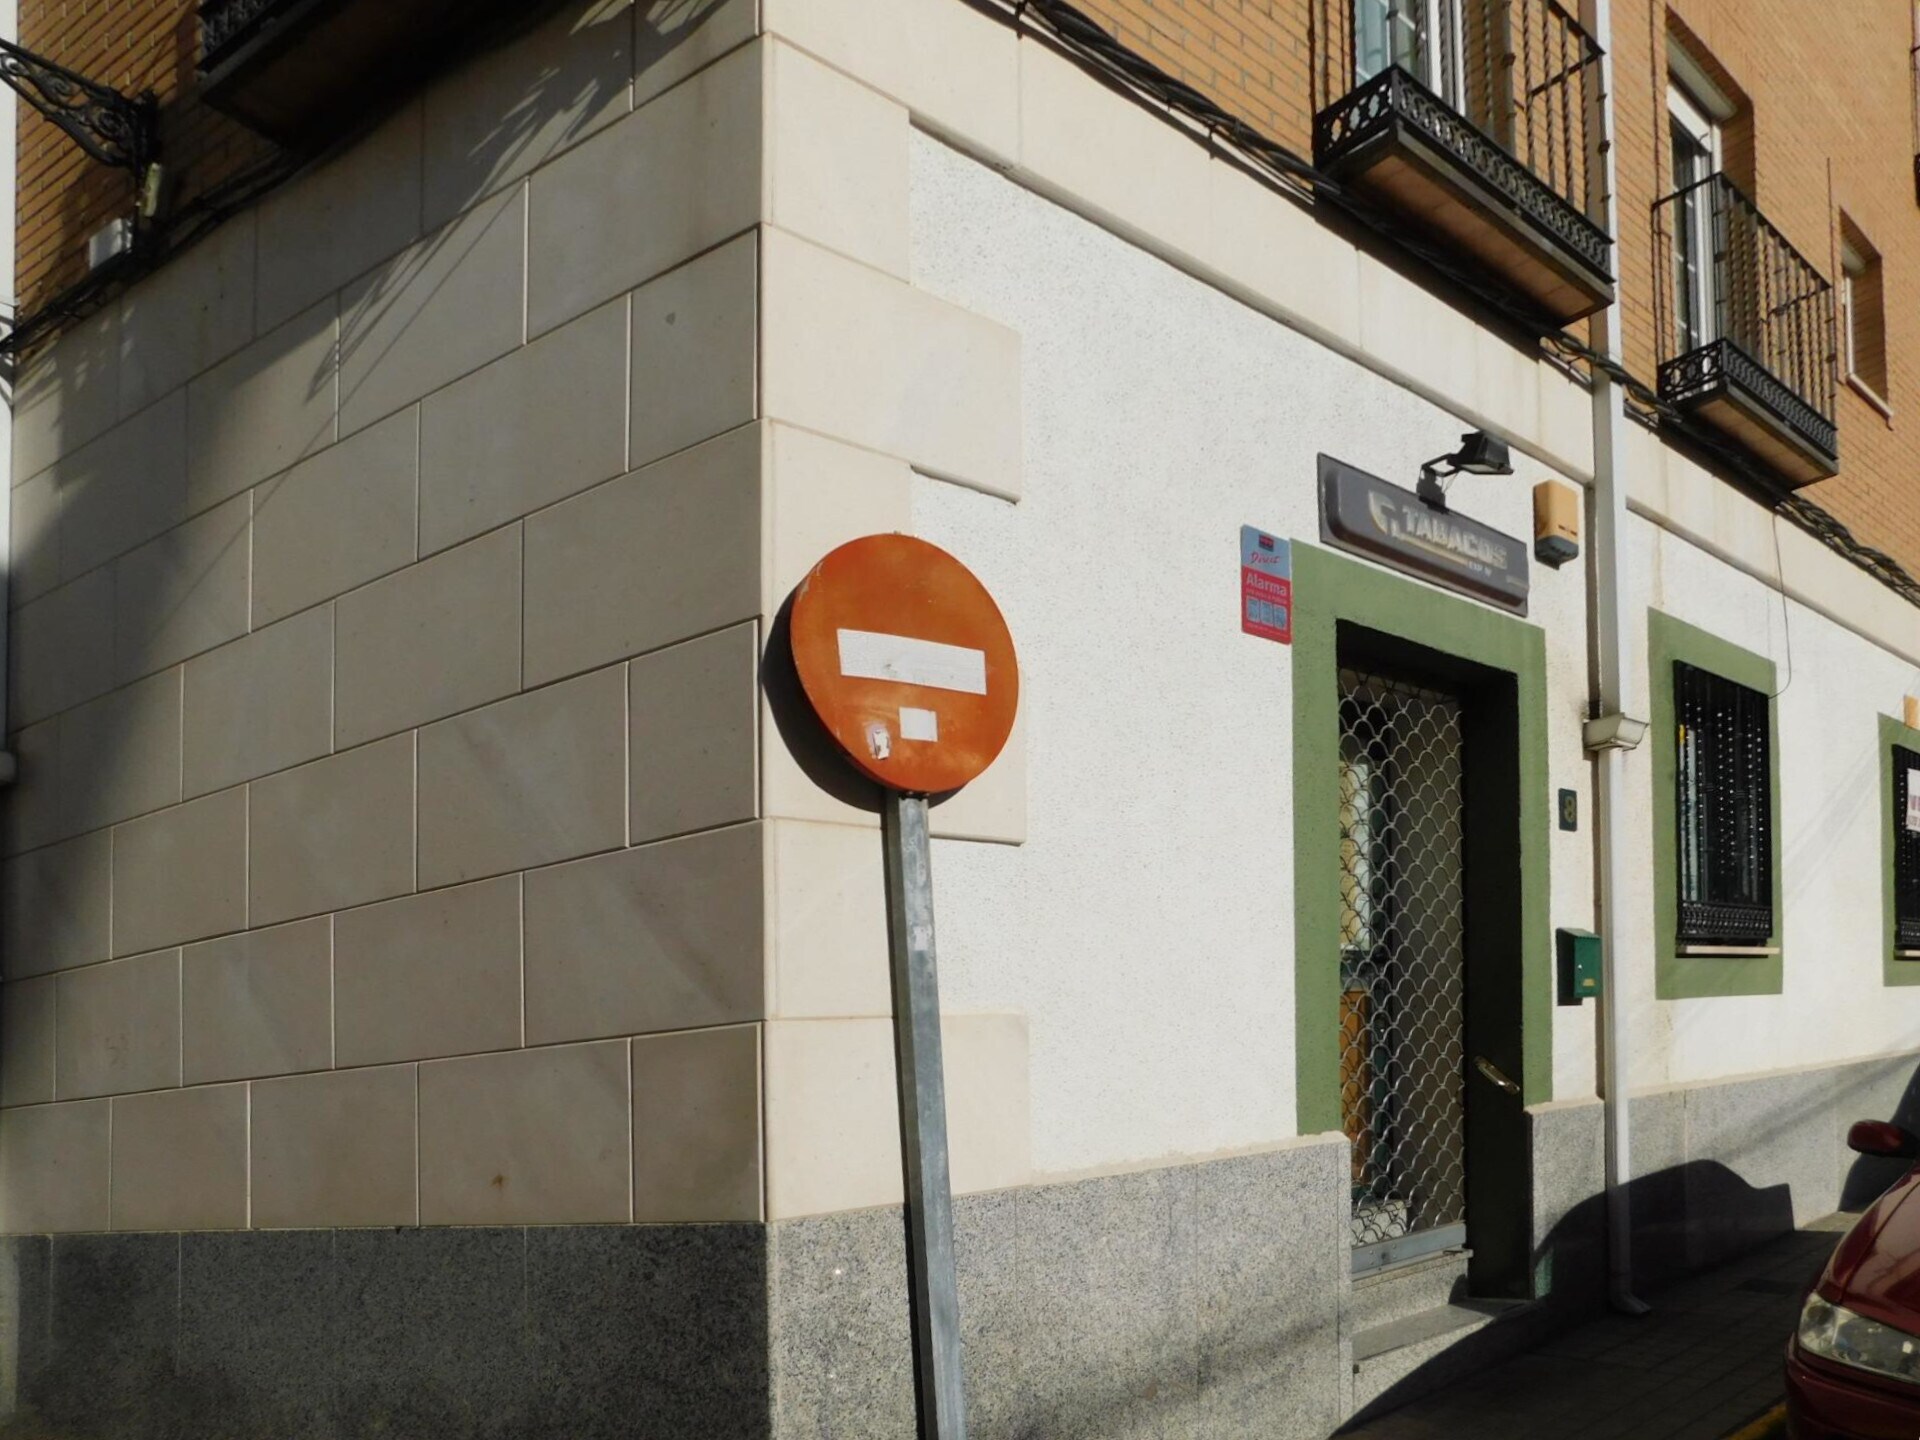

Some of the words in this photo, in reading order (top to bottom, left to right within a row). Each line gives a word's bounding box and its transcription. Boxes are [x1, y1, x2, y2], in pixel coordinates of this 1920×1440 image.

[1402, 506, 1508, 569] TABACOS
[1246, 572, 1287, 596] Alarma
[1564, 795, 1575, 823] 8
